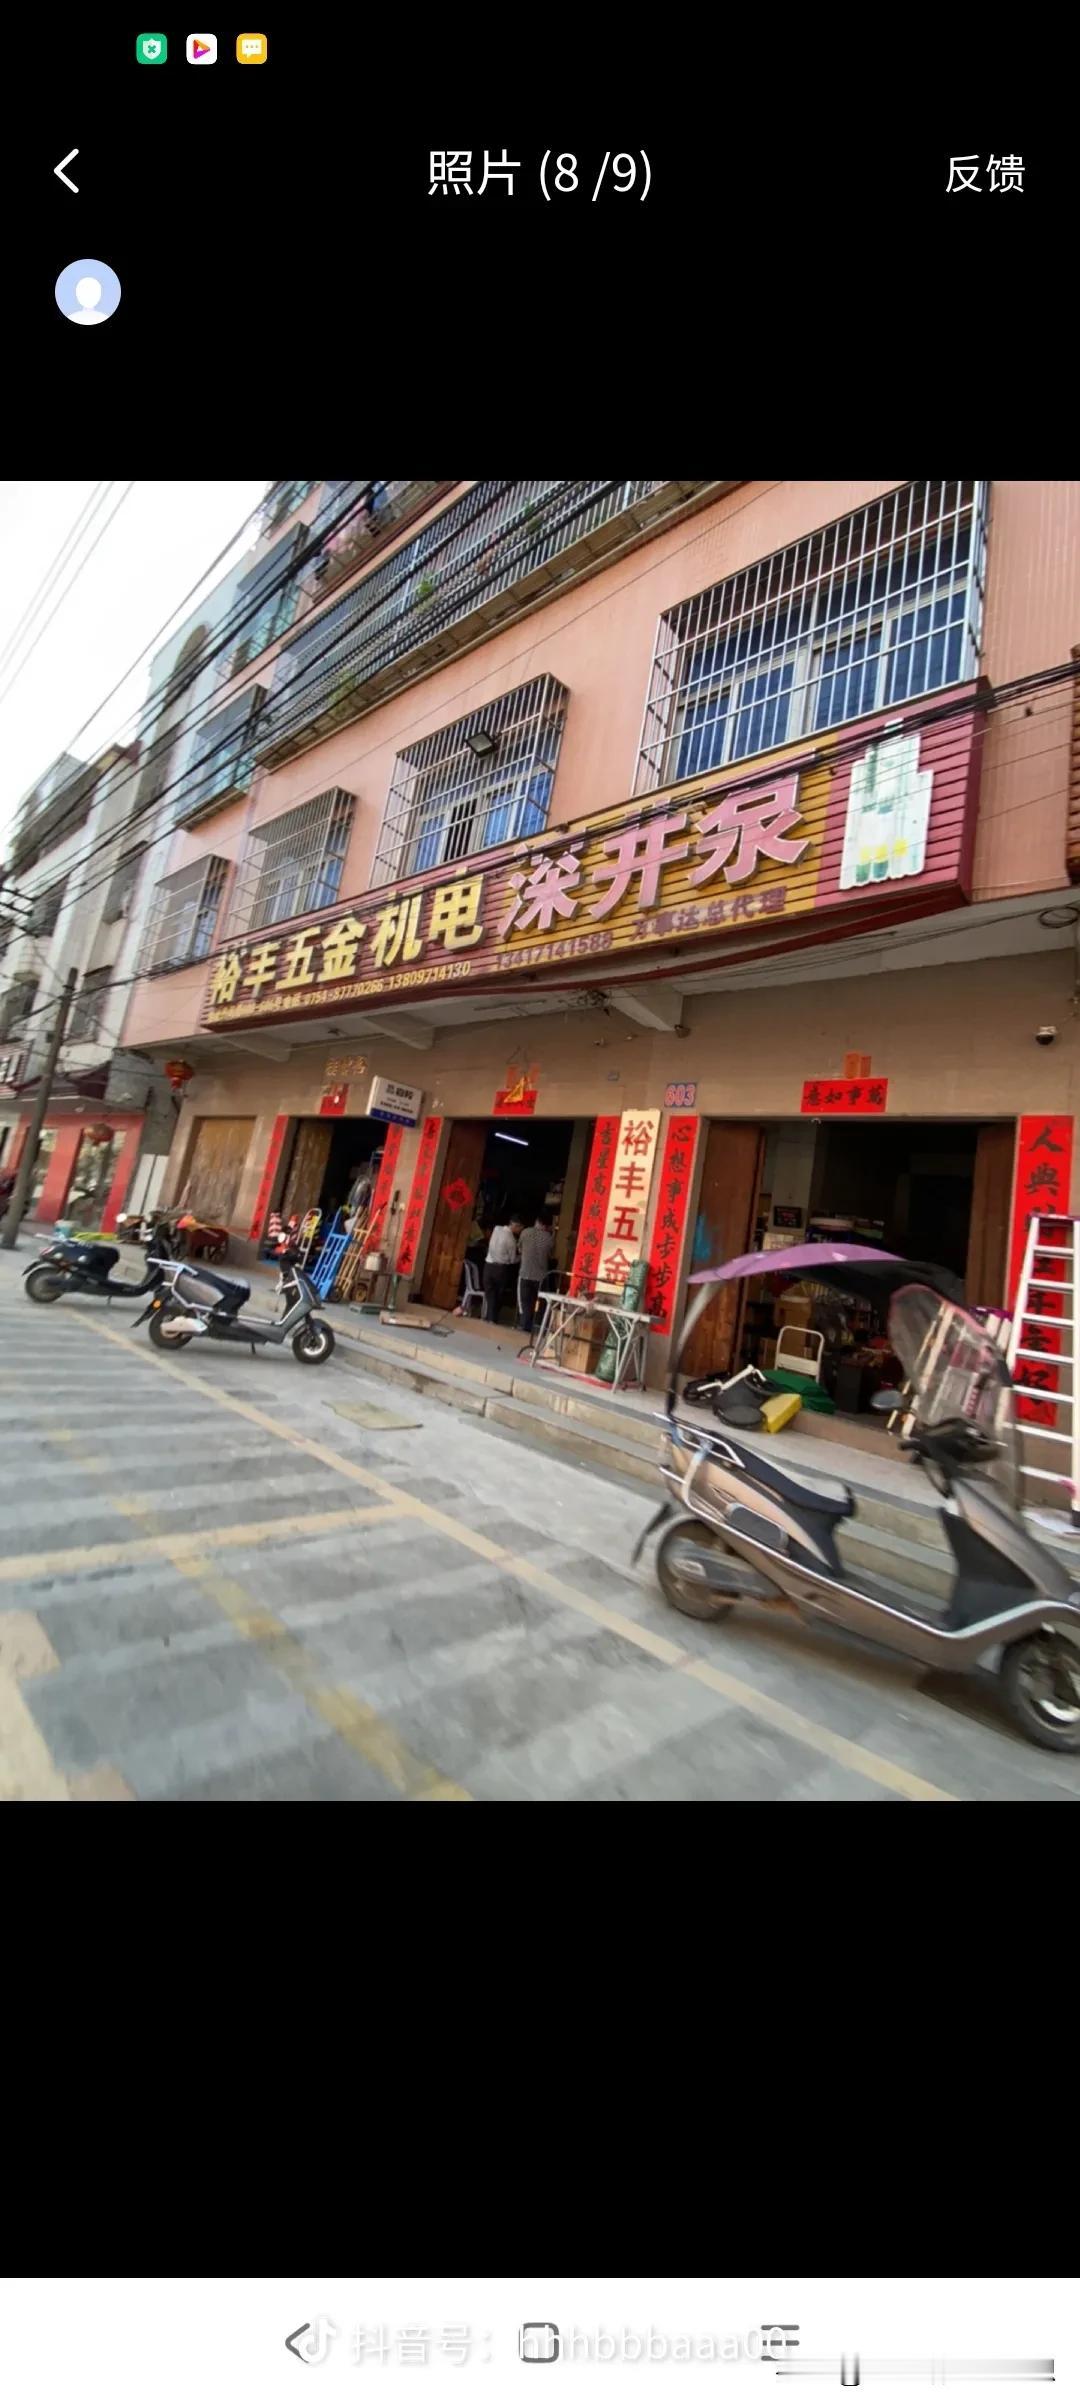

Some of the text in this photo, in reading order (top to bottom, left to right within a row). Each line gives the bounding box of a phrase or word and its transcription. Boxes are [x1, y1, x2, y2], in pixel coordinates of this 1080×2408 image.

[209, 867, 484, 1004] 裕丰五金机电
[664, 1084, 696, 1107] 603
[603, 1120, 654, 1284] 裕丰五金
